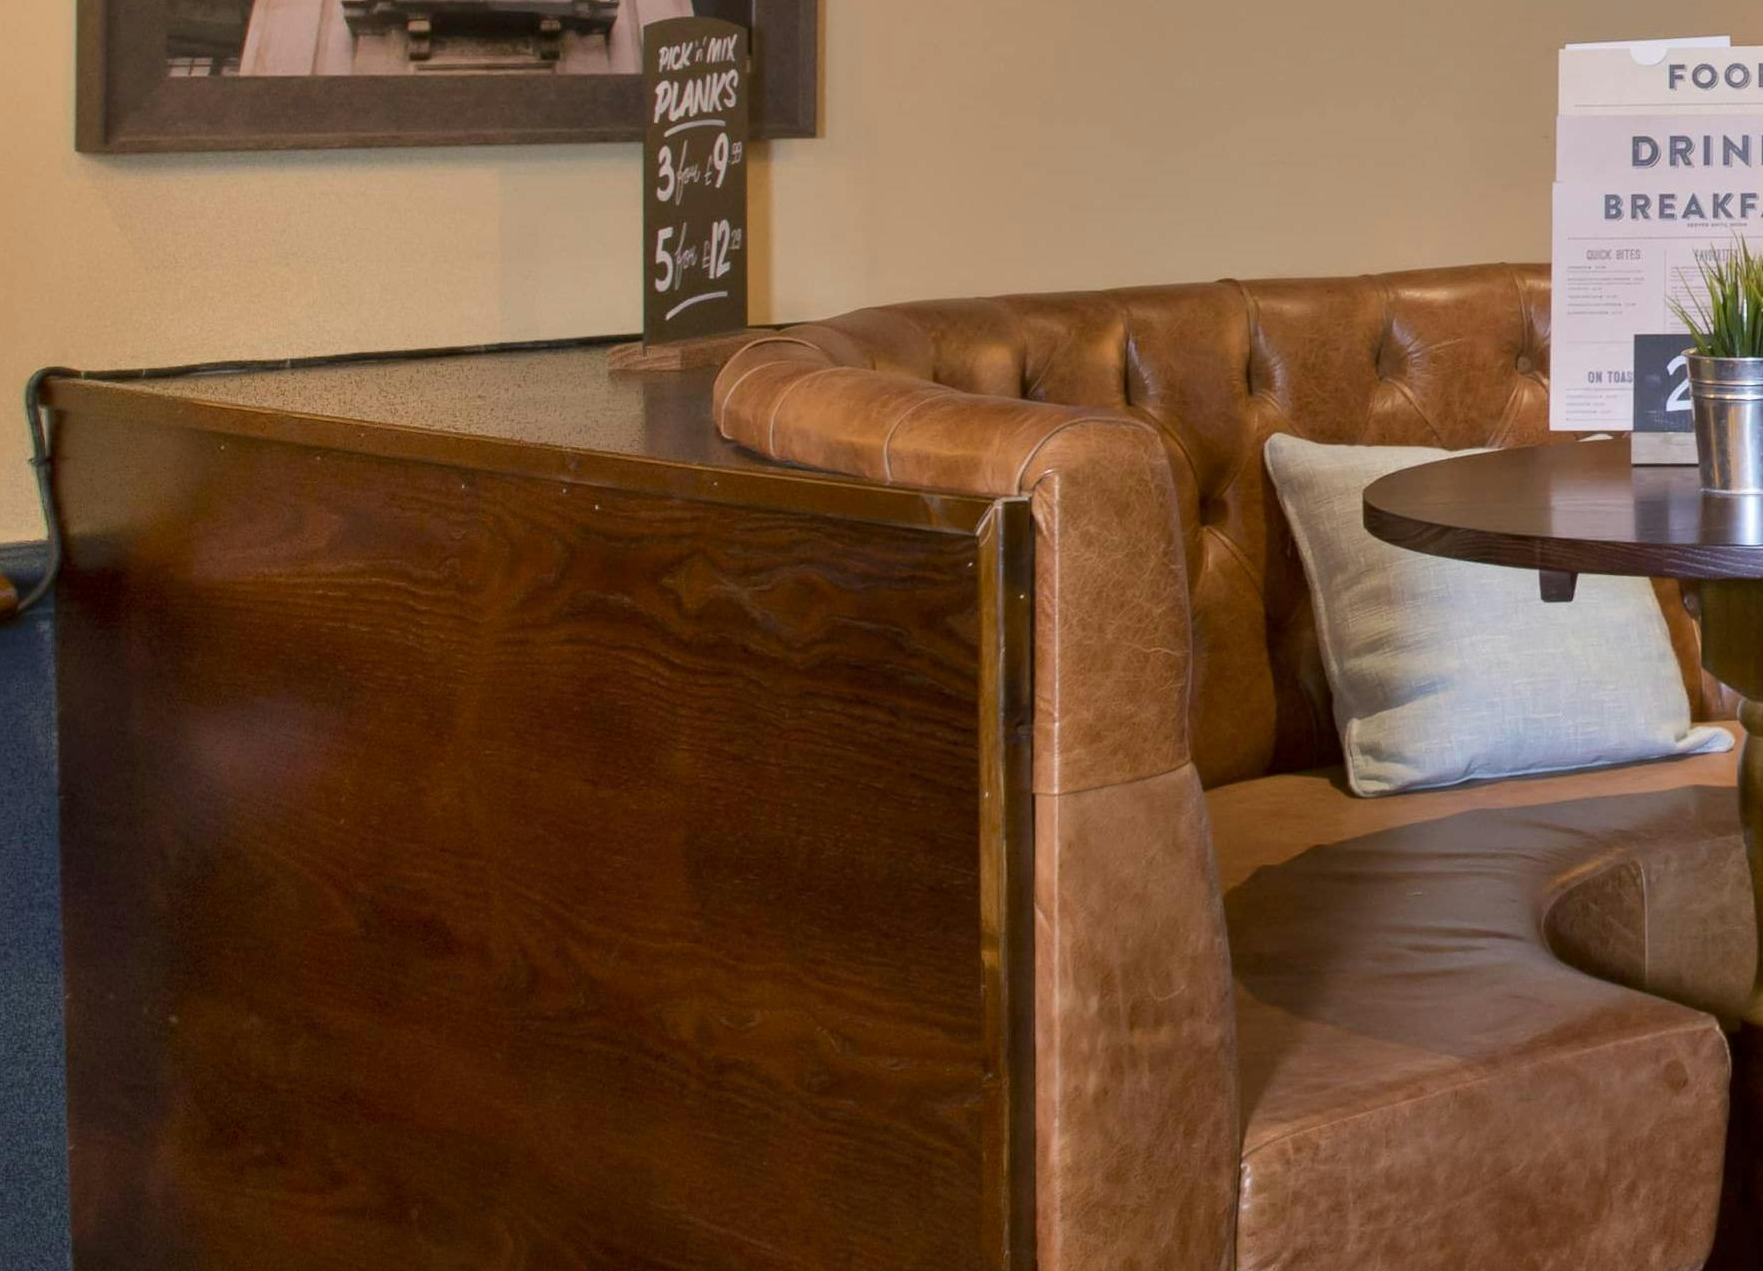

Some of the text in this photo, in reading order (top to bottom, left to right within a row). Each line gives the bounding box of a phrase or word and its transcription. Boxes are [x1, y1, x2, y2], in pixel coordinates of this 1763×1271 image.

[659, 42, 693, 73] PICK
[706, 34, 738, 63] MIX
[653, 69, 739, 123] PLANKS
[656, 145, 675, 202] 3
[675, 139, 701, 206] for
[654, 226, 673, 292] 5
[674, 222, 698, 290] for
[1586, 249, 1642, 260] QUICK BITES
[1588, 371, 1633, 383] ON TOAS
